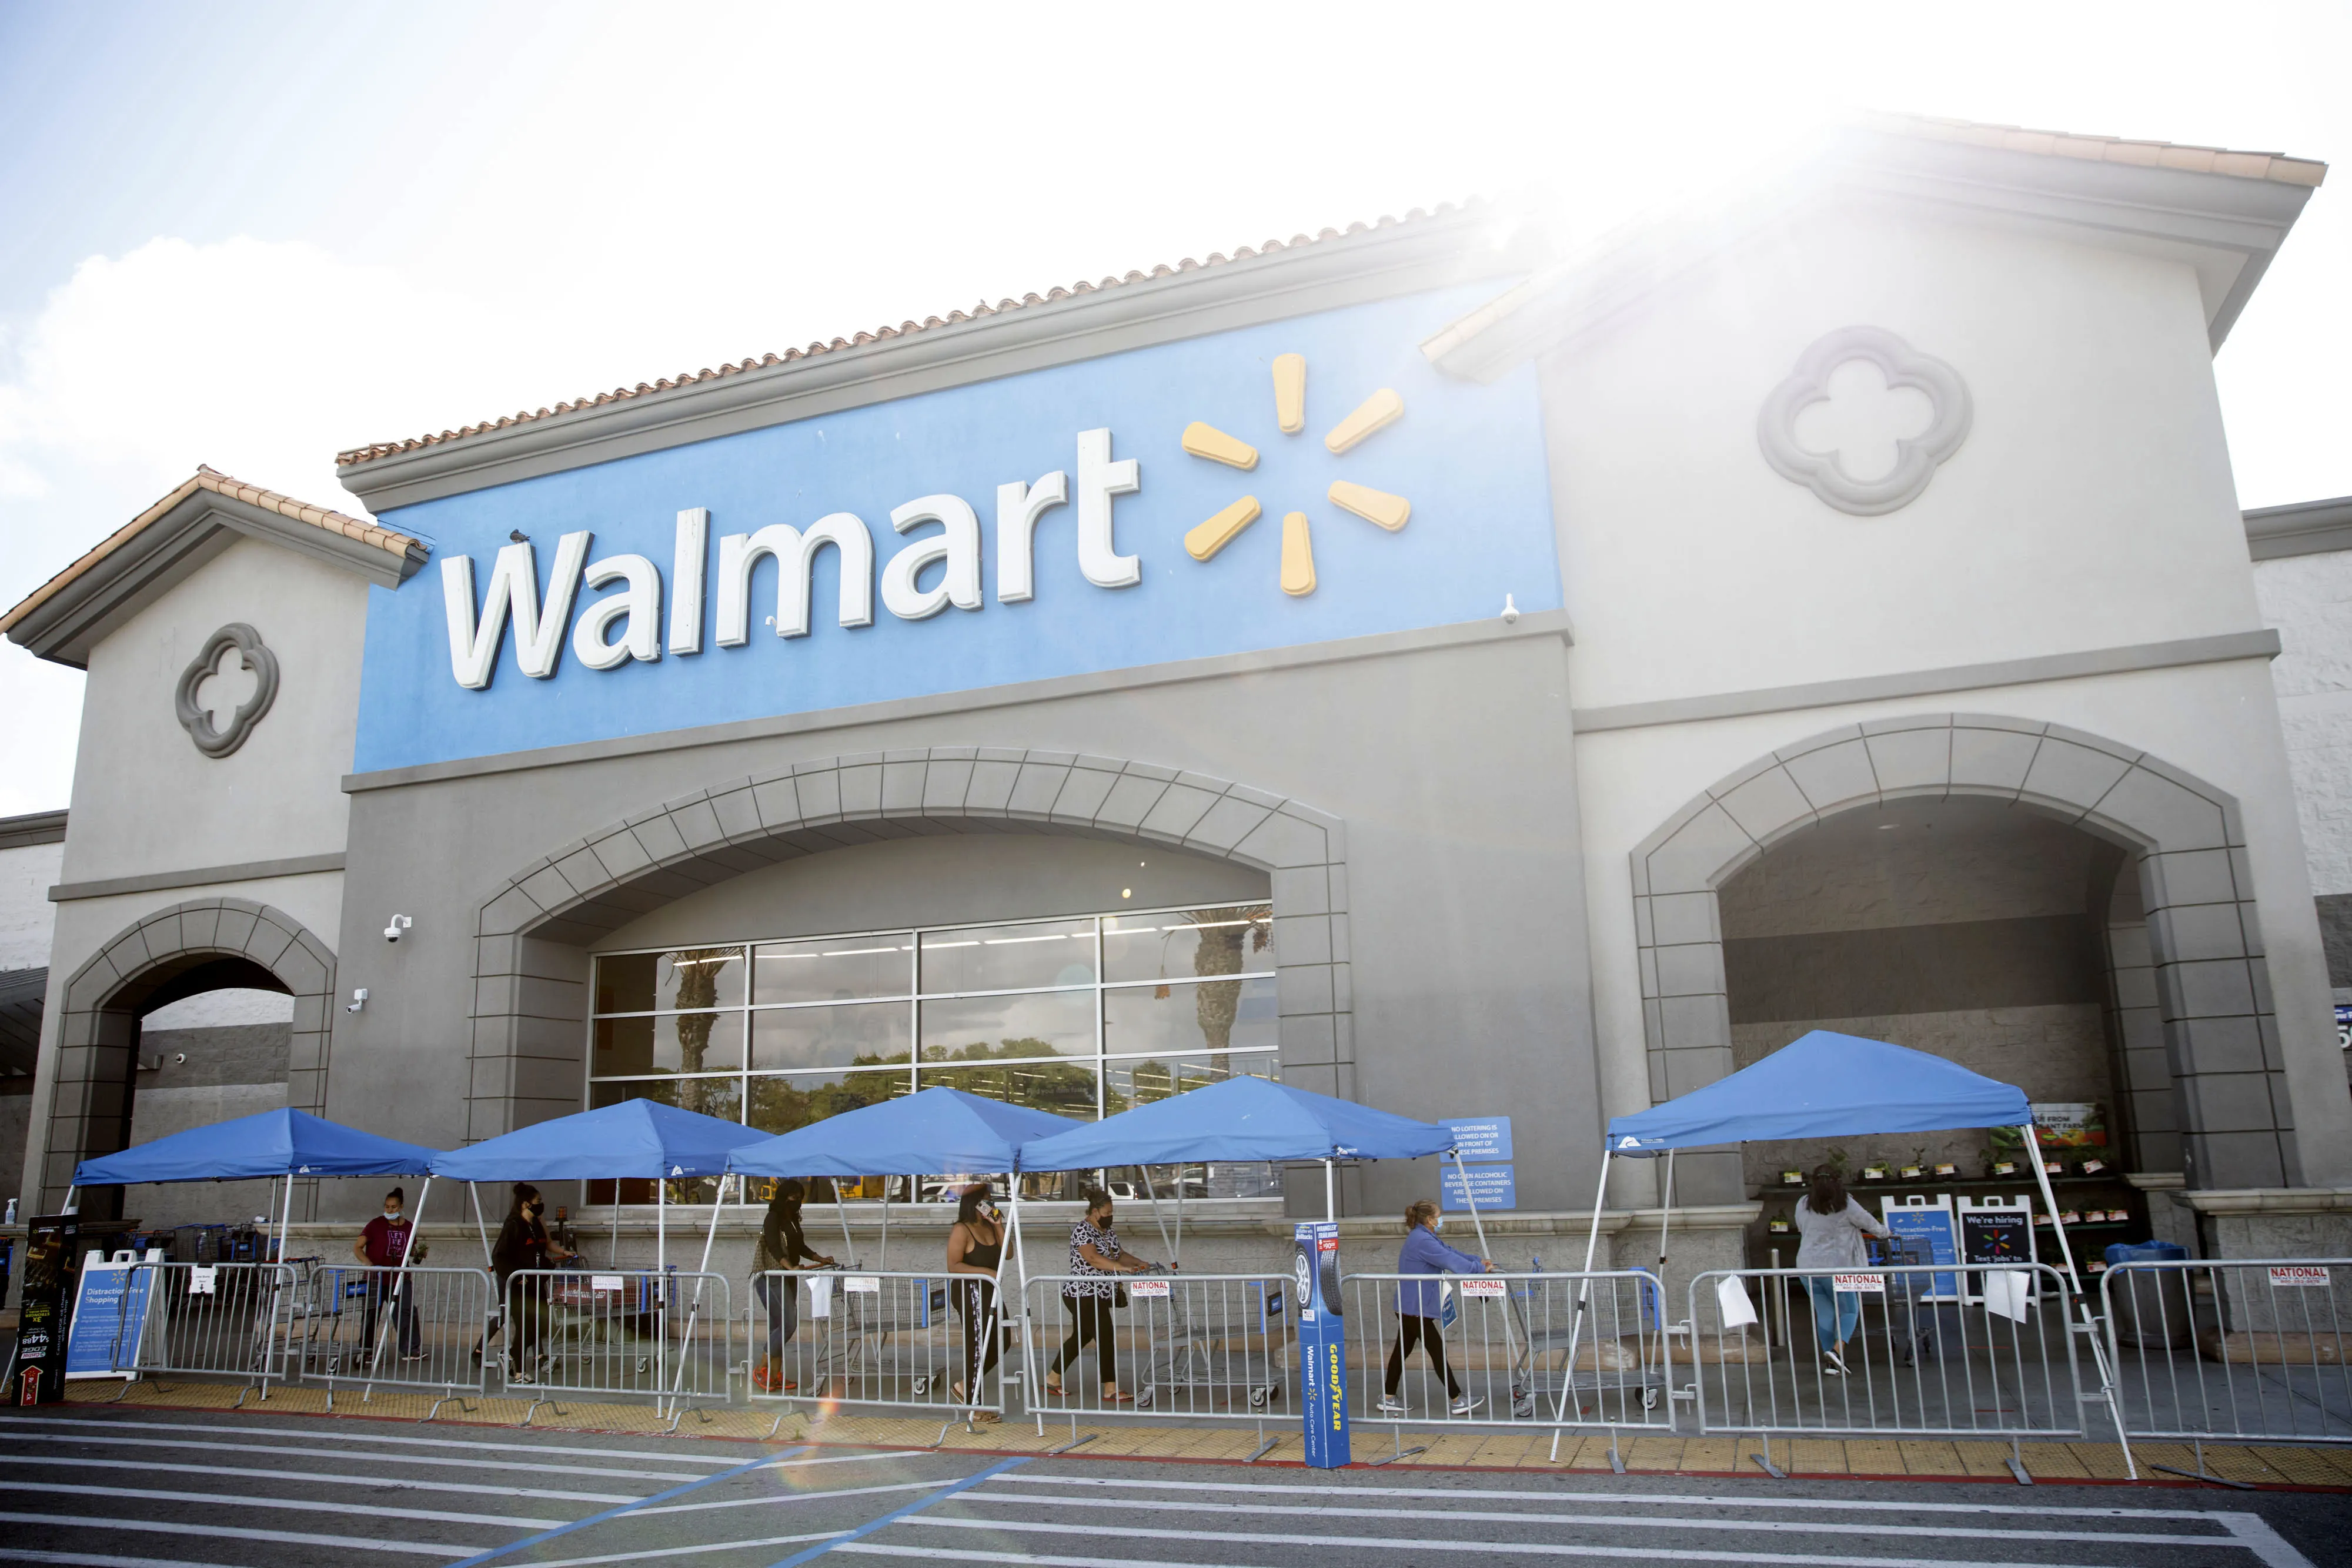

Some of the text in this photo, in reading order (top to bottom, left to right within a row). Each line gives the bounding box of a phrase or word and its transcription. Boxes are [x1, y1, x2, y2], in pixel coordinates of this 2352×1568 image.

[440, 427, 1141, 691] Walmart
[1994, 1216, 2023, 1225] hiring
[2271, 1268, 2327, 1277] NATIONAL
[1835, 1275, 1882, 1283] NATIONAL
[85, 1296, 118, 1305] Shopping
[1307, 1346, 1315, 1386] Walmart
[1329, 1343, 1343, 1432] GOODYEAR
